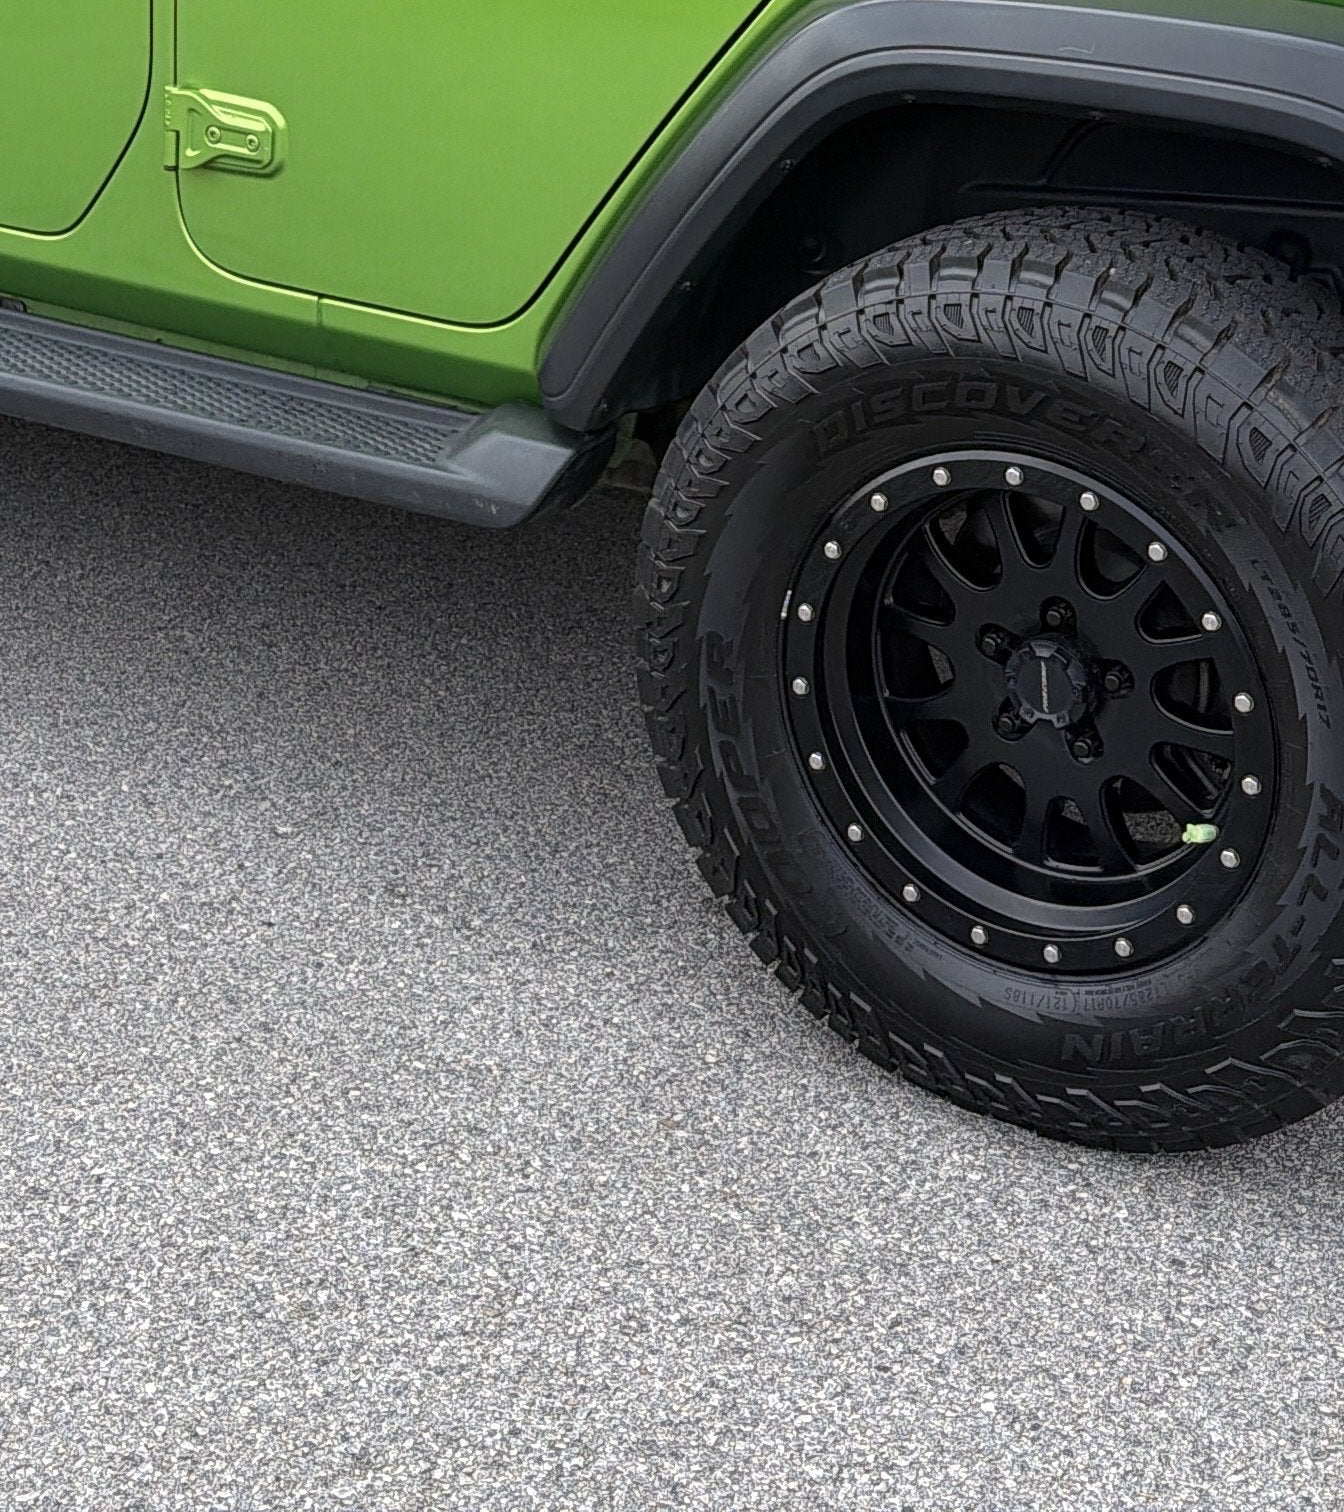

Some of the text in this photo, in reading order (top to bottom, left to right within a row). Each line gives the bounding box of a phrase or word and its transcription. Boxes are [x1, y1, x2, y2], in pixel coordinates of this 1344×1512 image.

[811, 376, 1248, 528] DISCOVERR
[1248, 557, 1333, 731] LT285/70R17
[1060, 782, 1344, 1064] ALL-TERRAIN
